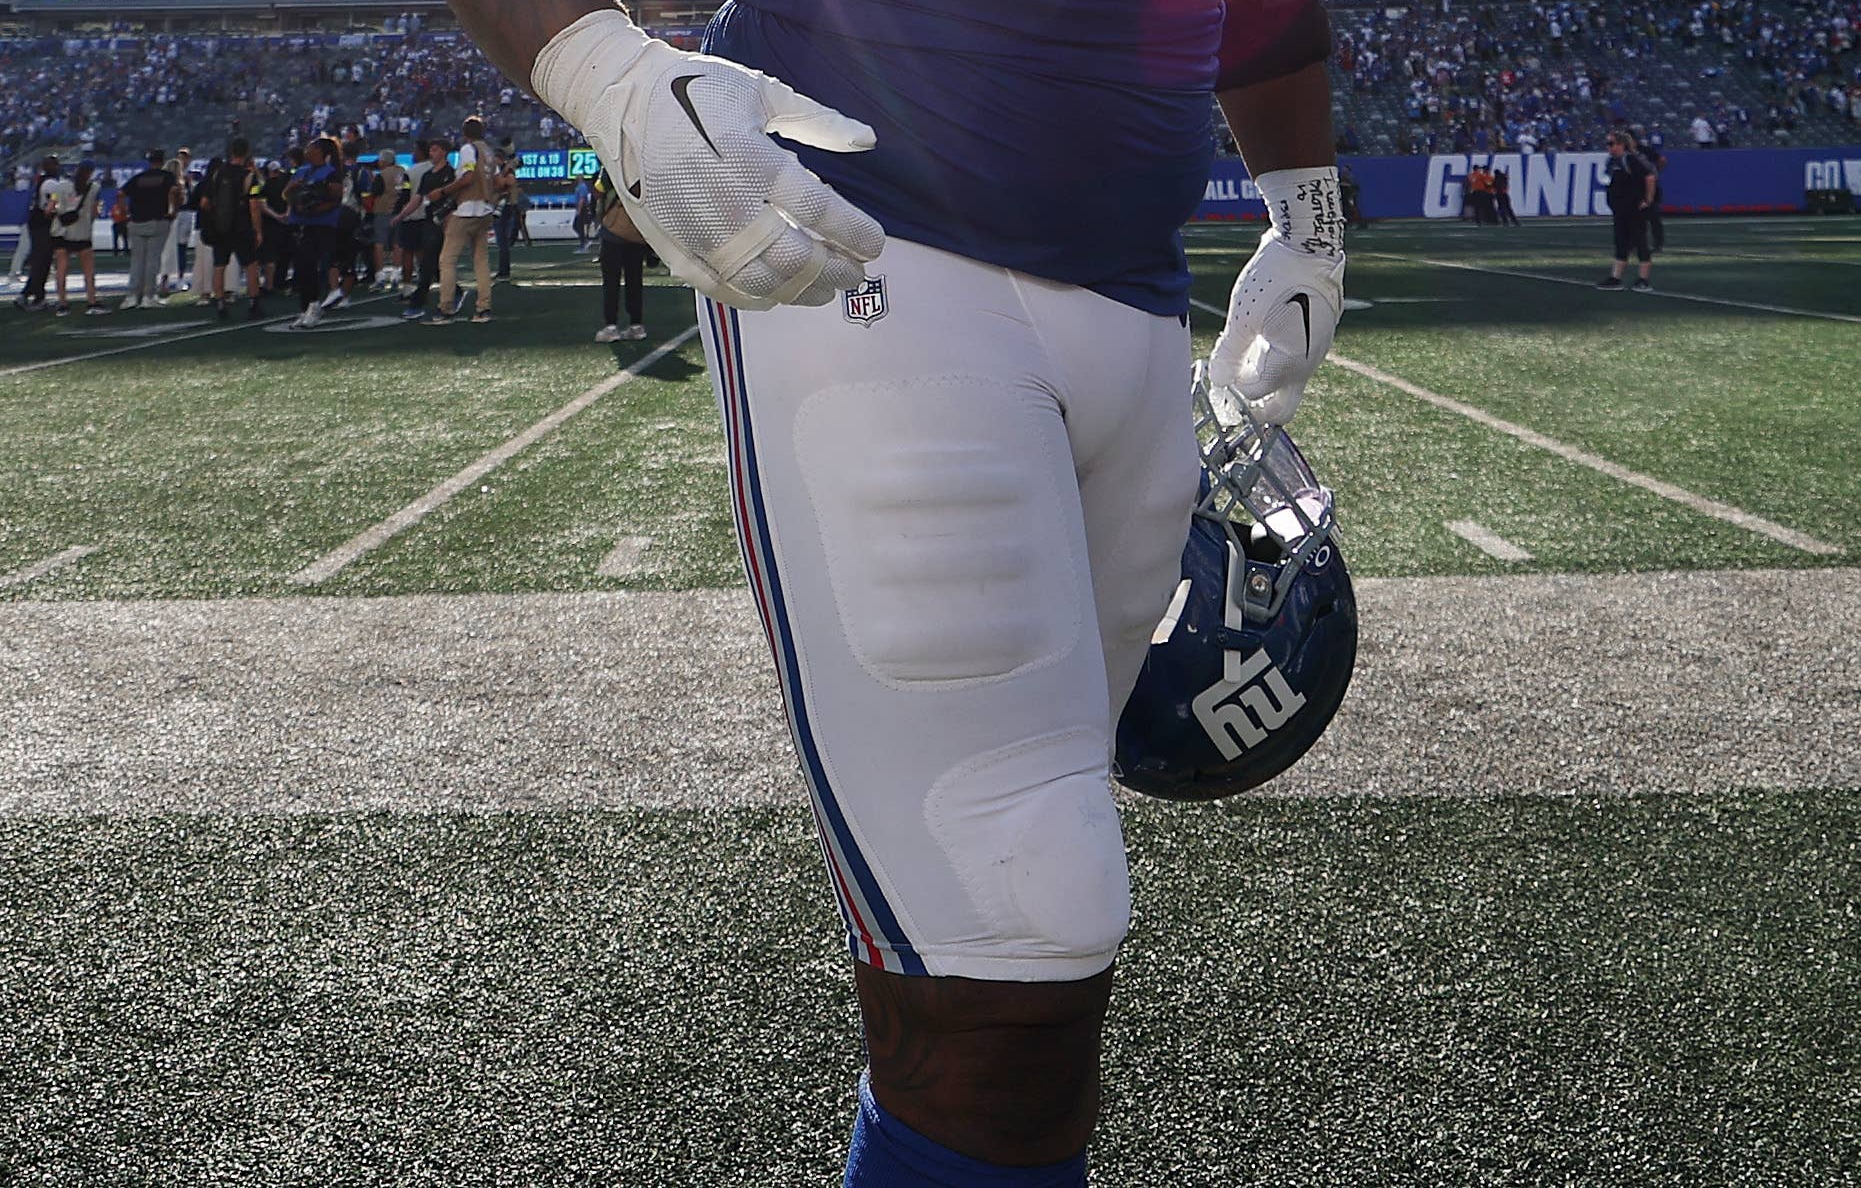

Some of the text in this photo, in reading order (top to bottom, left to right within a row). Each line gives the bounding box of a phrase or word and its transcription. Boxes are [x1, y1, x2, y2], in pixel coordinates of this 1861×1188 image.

[572, 152, 599, 175] 25
[1203, 179, 1240, 201] ALL
[849, 295, 881, 316] NFL
